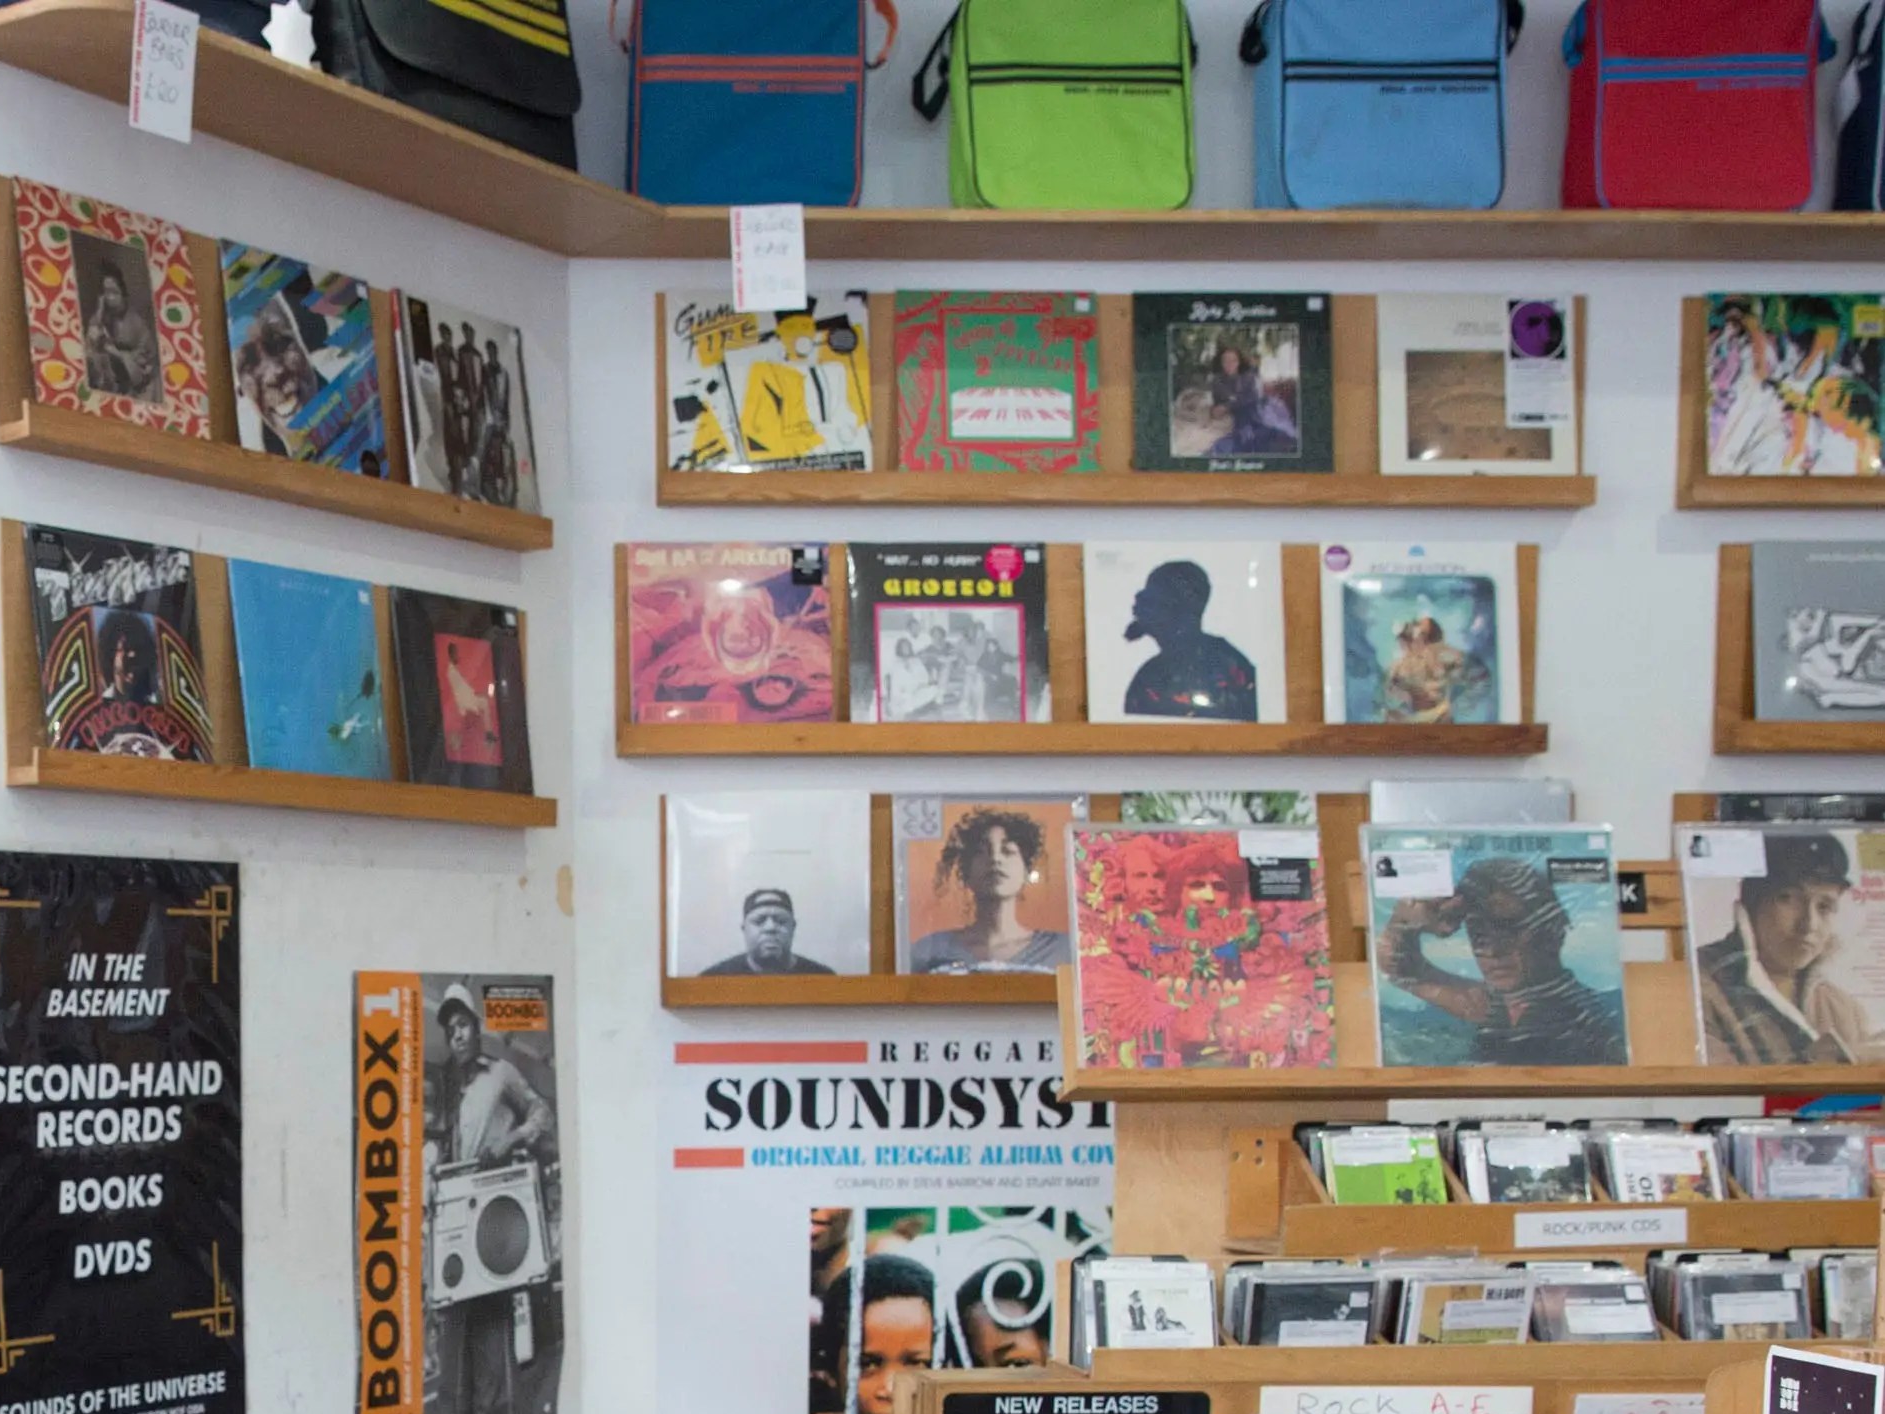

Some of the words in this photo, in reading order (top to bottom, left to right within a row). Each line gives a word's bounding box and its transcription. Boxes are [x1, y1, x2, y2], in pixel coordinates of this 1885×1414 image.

[67, 953, 99, 983] IN
[103, 953, 148, 983] THE
[45, 988, 172, 1019] BASEMENT
[363, 986, 401, 1019] 1
[878, 1040, 1056, 1063] REGGAE
[704, 1075, 1115, 1133] SOUNDSYST
[36, 1104, 183, 1150] RECORDS
[750, 1144, 866, 1169] ORIGINAL
[874, 1144, 973, 1168] REGGAE
[979, 1143, 1065, 1168] ALBUM
[1071, 1143, 1115, 1168] COV
[58, 1172, 164, 1215] BOOKS
[834, 1175, 894, 1191] COMPILED
[895, 1176, 910, 1190] BY
[912, 1175, 945, 1190] STEVE
[946, 1175, 997, 1190] BARROW
[998, 1175, 1024, 1190] AND
[1025, 1175, 1063, 1190] STUART
[1064, 1174, 1102, 1189] BAKER
[363, 1029, 402, 1411] BOOMBOX
[1542, 1218, 1627, 1238] ROCK/PUNK
[73, 1237, 153, 1280] DVDS
[79, 1389, 106, 1414] OF
[107, 1382, 141, 1410] THE
[143, 1370, 228, 1404] UNIVERSE
[995, 1395, 1044, 1414] NEW
